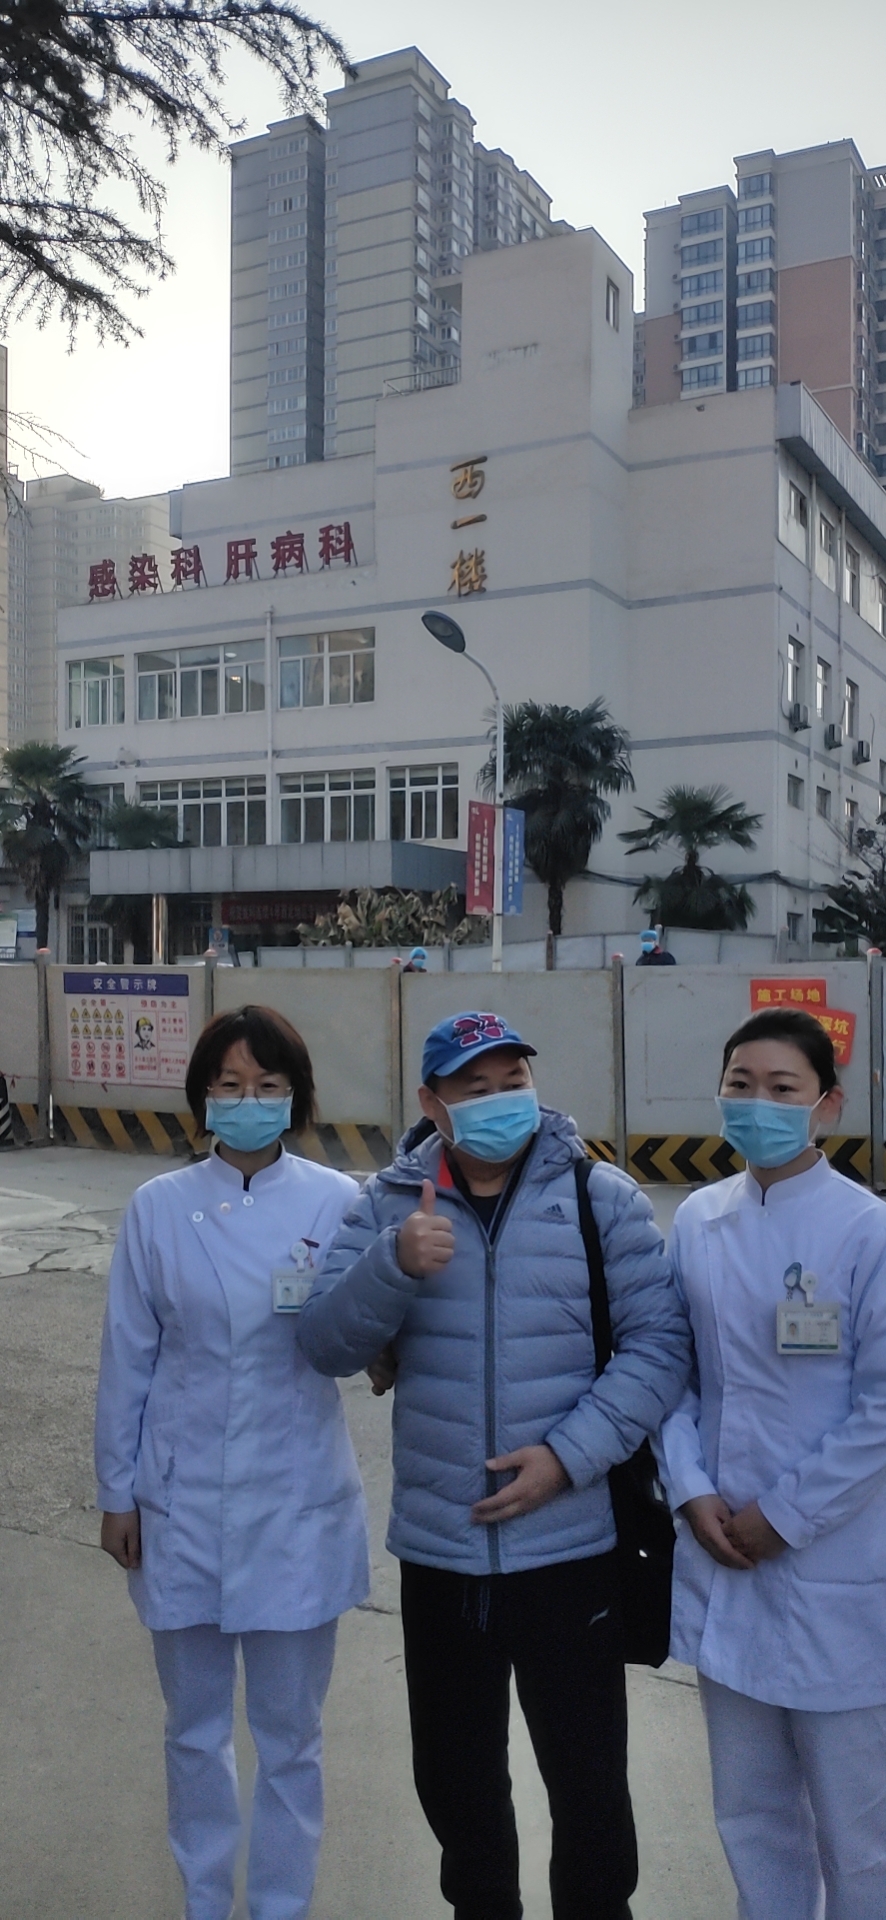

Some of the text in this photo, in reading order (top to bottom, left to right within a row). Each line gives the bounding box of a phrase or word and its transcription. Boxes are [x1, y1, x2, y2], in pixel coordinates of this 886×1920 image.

[447, 455, 488, 598] 西一楼
[88, 522, 354, 599] 感染科 肝病科
[93, 978, 157, 991] 安全警示牌
[757, 989, 820, 1003] 施工场地
